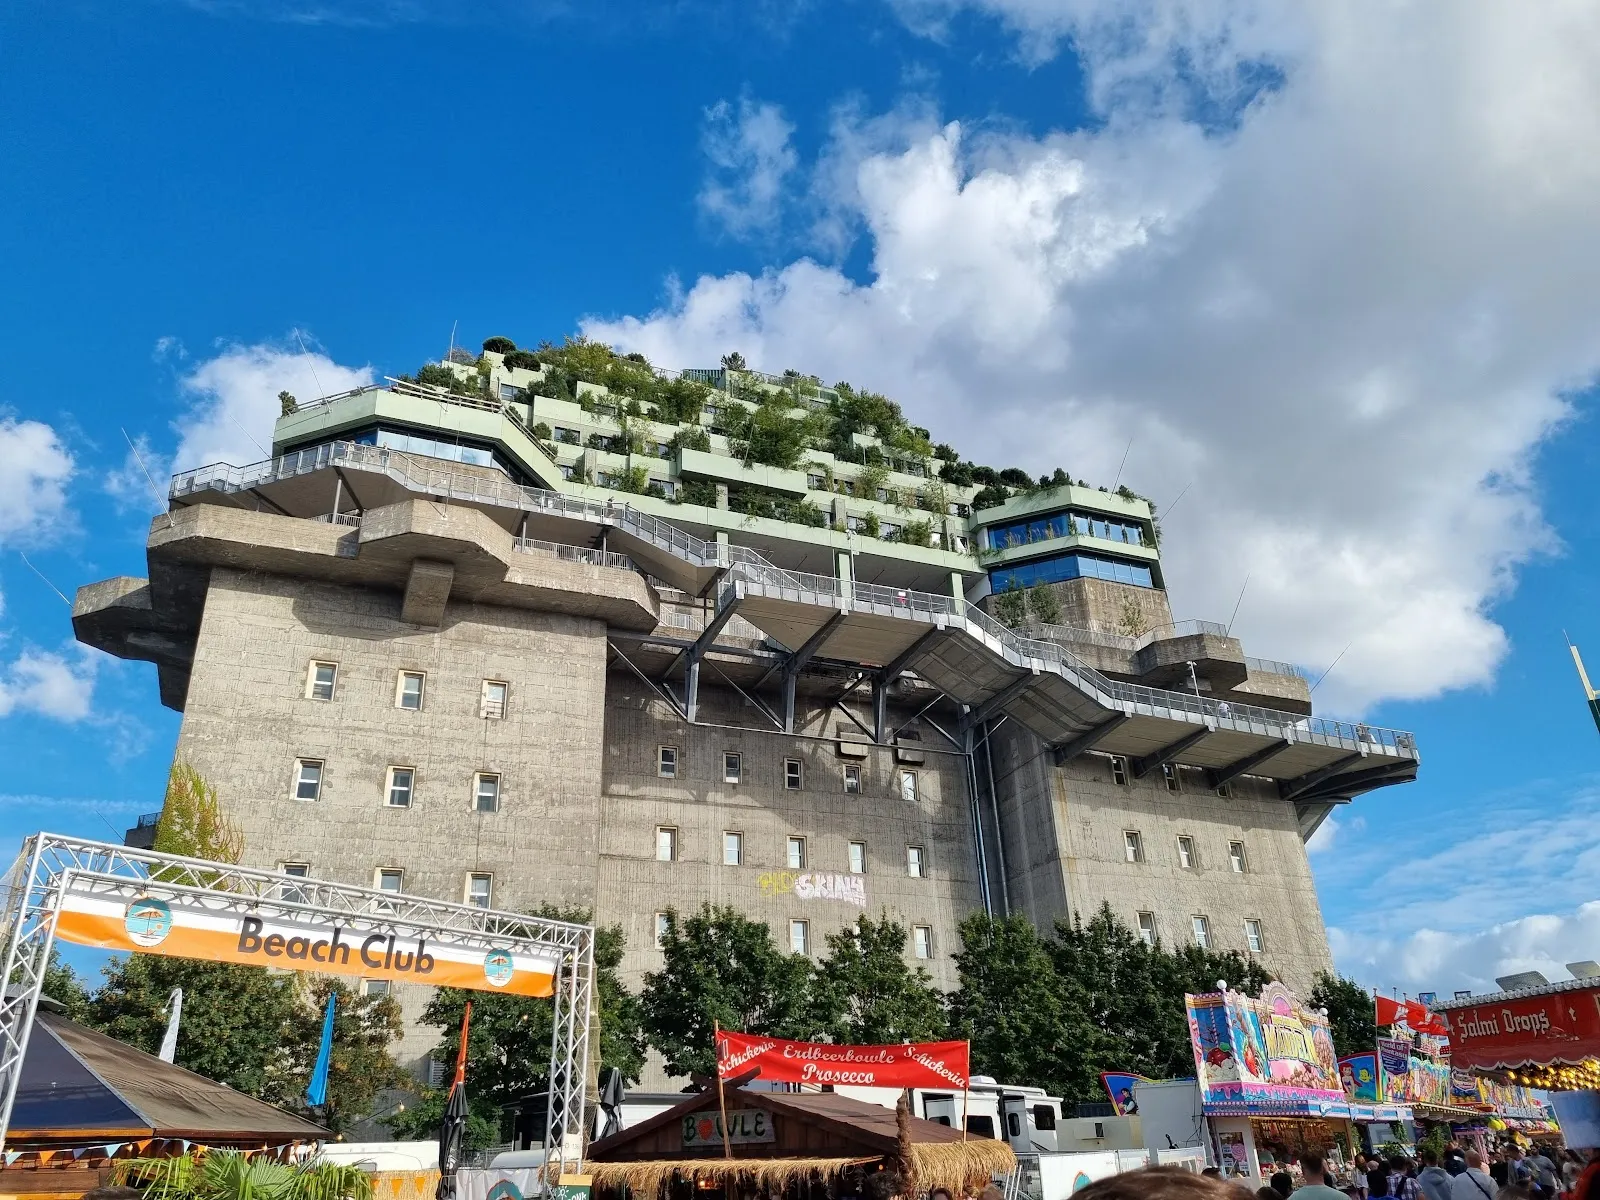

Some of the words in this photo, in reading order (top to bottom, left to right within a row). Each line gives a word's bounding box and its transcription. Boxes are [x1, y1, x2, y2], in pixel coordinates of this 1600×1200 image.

[238, 916, 350, 965] Beach
[360, 934, 435, 975] Club
[1457, 1009, 1500, 1044] Salmi
[1501, 1008, 1550, 1037] Drops
[718, 1042, 776, 1076] Schickeria
[784, 1044, 895, 1064] Erdbeerbowle
[903, 1046, 966, 1088] Schickeria
